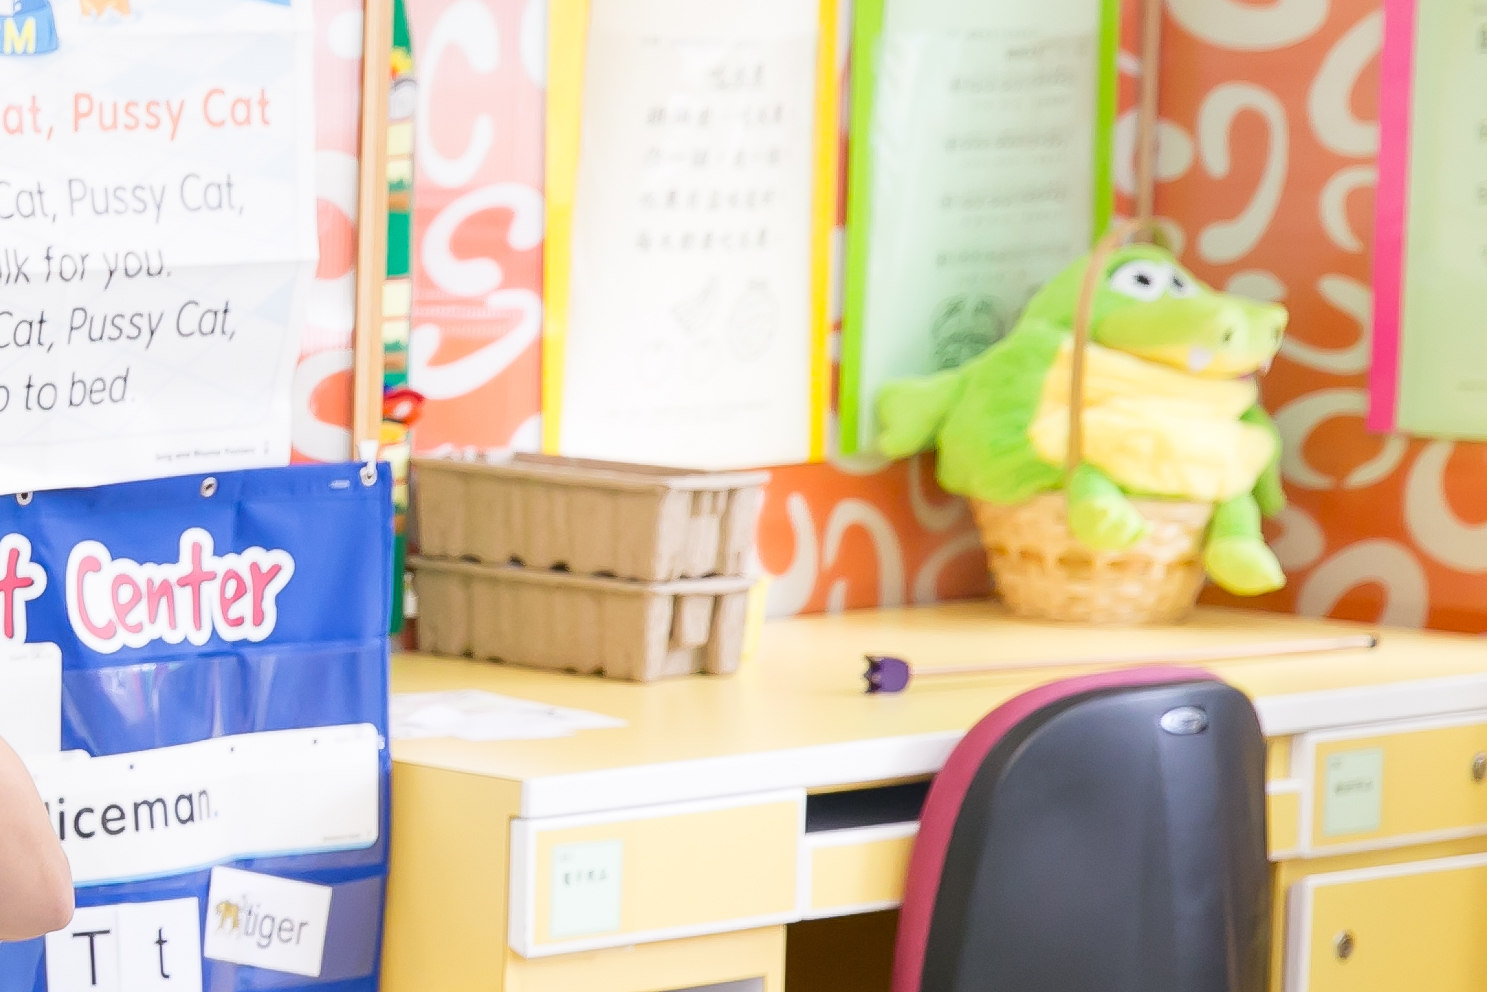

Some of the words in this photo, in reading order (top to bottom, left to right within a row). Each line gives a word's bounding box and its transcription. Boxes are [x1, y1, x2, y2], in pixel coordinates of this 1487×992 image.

[1, 16, 38, 56] M
[73, 92, 185, 141] Pussy
[202, 88, 271, 129] Cat
[68, 177, 167, 225] Pussy
[179, 172, 245, 216] Cat,
[44, 246, 89, 284] for
[103, 249, 172, 291] you.
[67, 307, 165, 351] Pussy
[175, 300, 237, 342] Cat,
[24, 375, 59, 412] to
[76, 540, 283, 641] Center
[45, 788, 219, 841] iceman.
[72, 928, 111, 986] T
[154, 926, 170, 980] t
